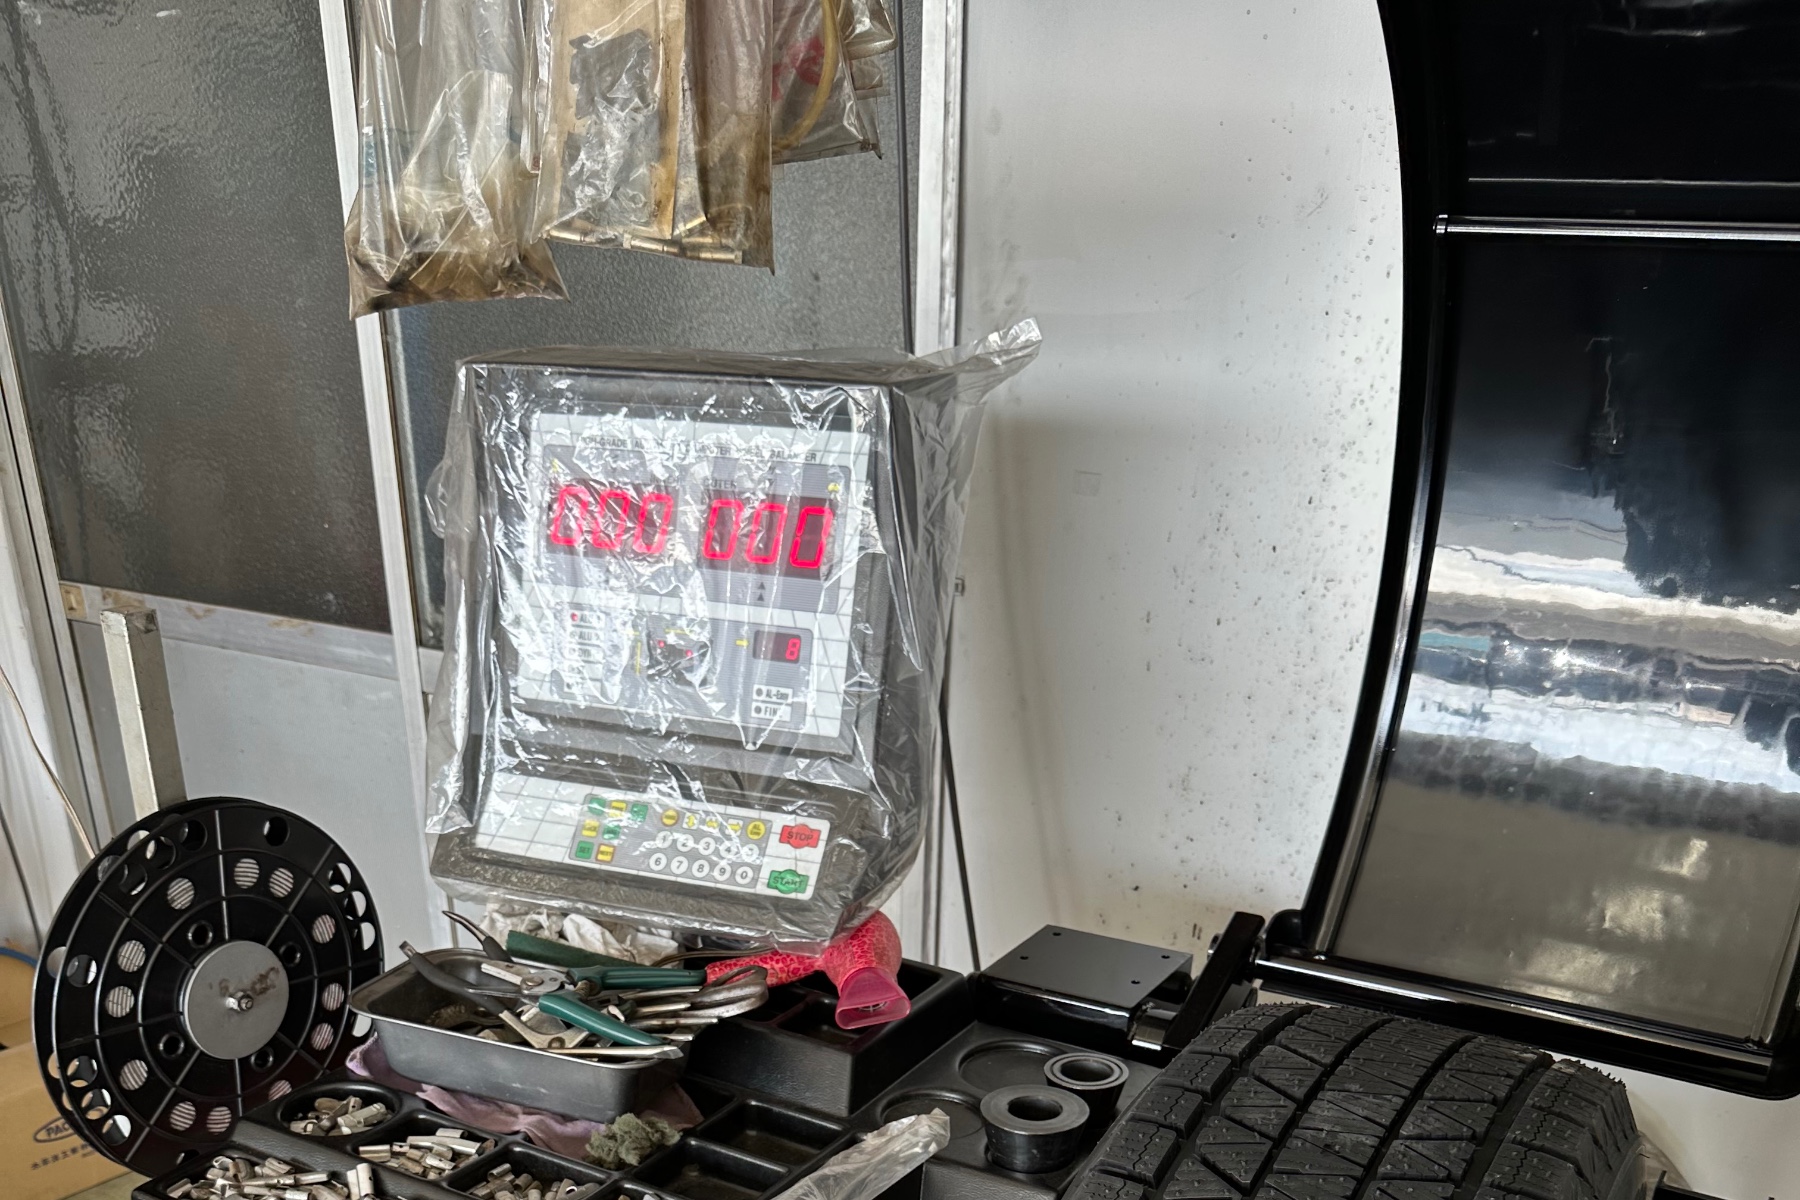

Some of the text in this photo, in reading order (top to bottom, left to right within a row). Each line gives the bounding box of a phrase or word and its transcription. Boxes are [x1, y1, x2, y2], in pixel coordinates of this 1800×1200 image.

[702, 499, 833, 569] 000
[785, 637, 801, 661] 8
[703, 841, 710, 850] 3
[787, 831, 814, 841] STOP
[654, 858, 748, 879] 6 7 8 9 0
